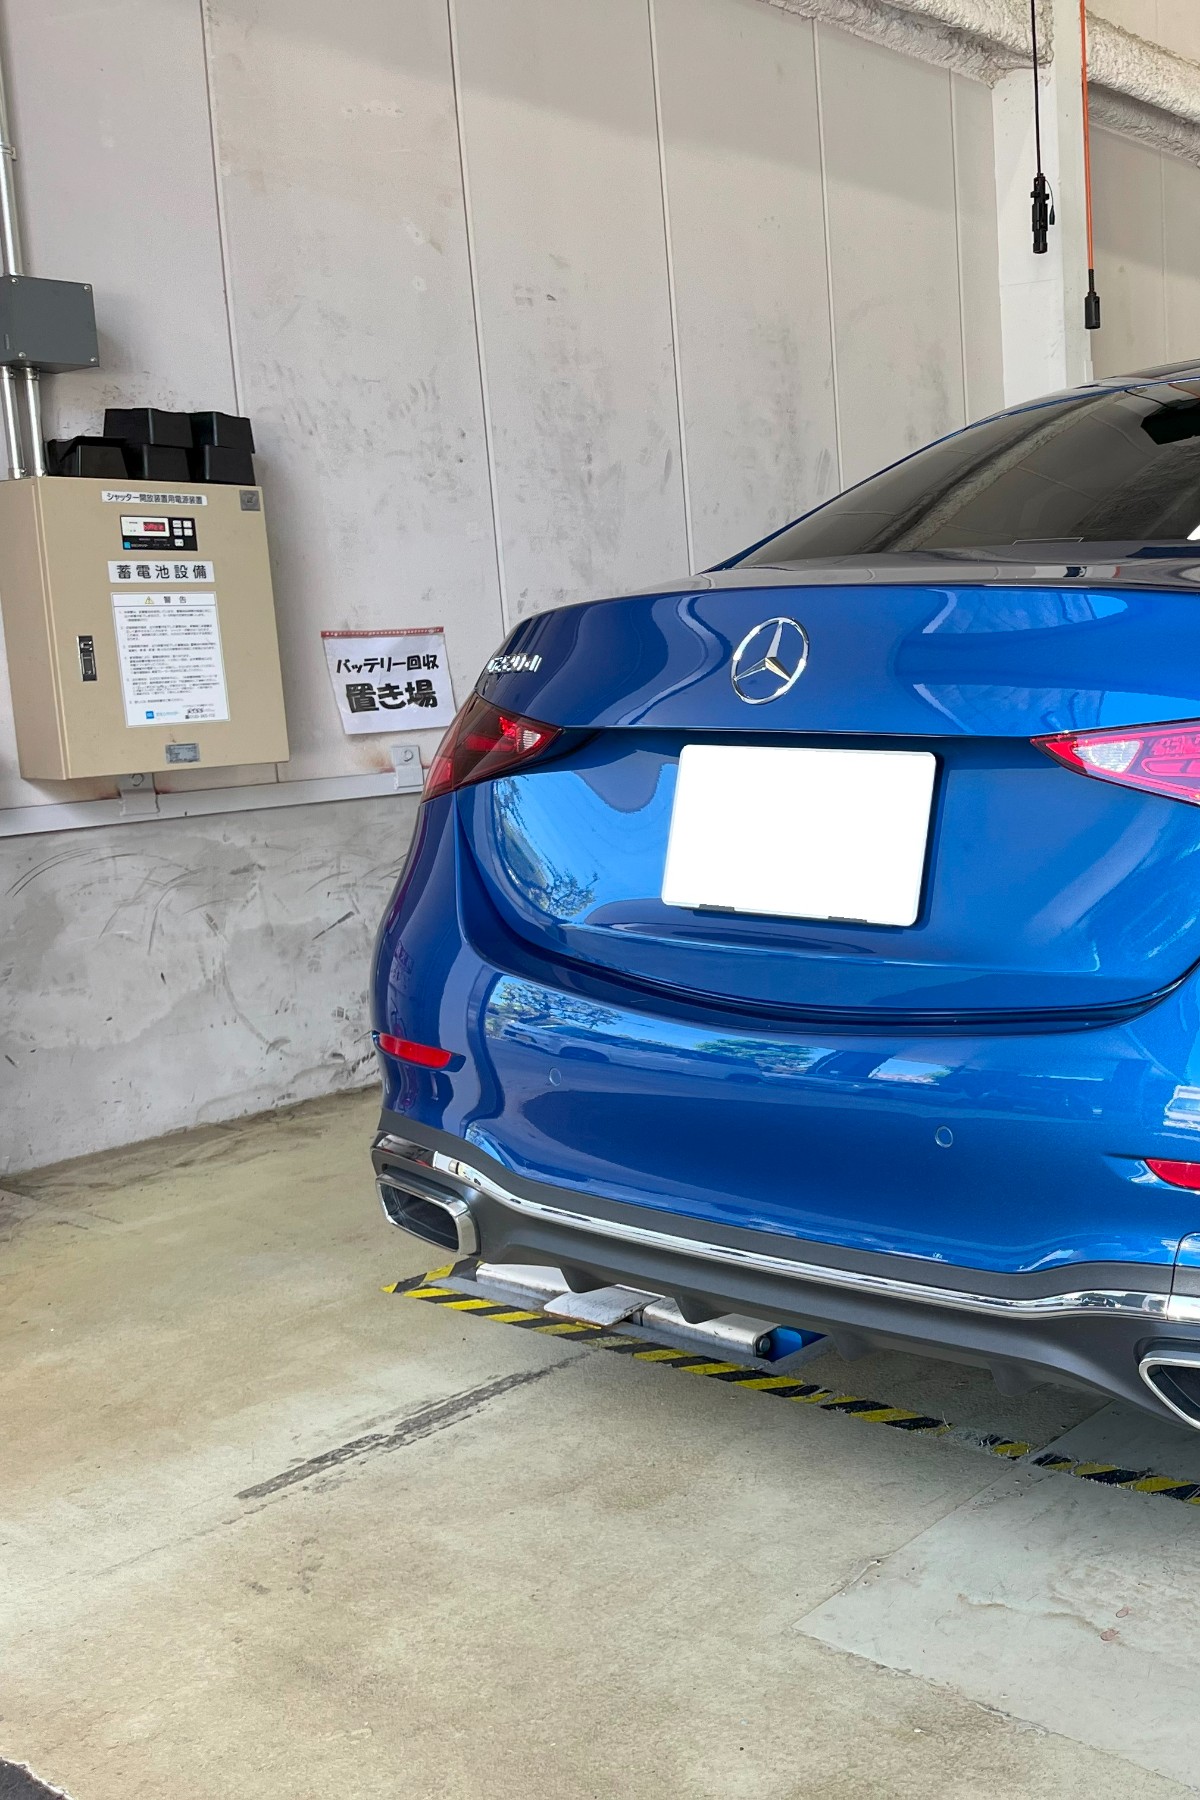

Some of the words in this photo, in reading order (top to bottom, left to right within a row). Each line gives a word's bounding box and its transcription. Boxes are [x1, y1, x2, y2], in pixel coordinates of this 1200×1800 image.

[117, 564, 207, 579] 蓄電池設備
[336, 654, 440, 674] バッテリー回収
[345, 679, 438, 713] 置き場
